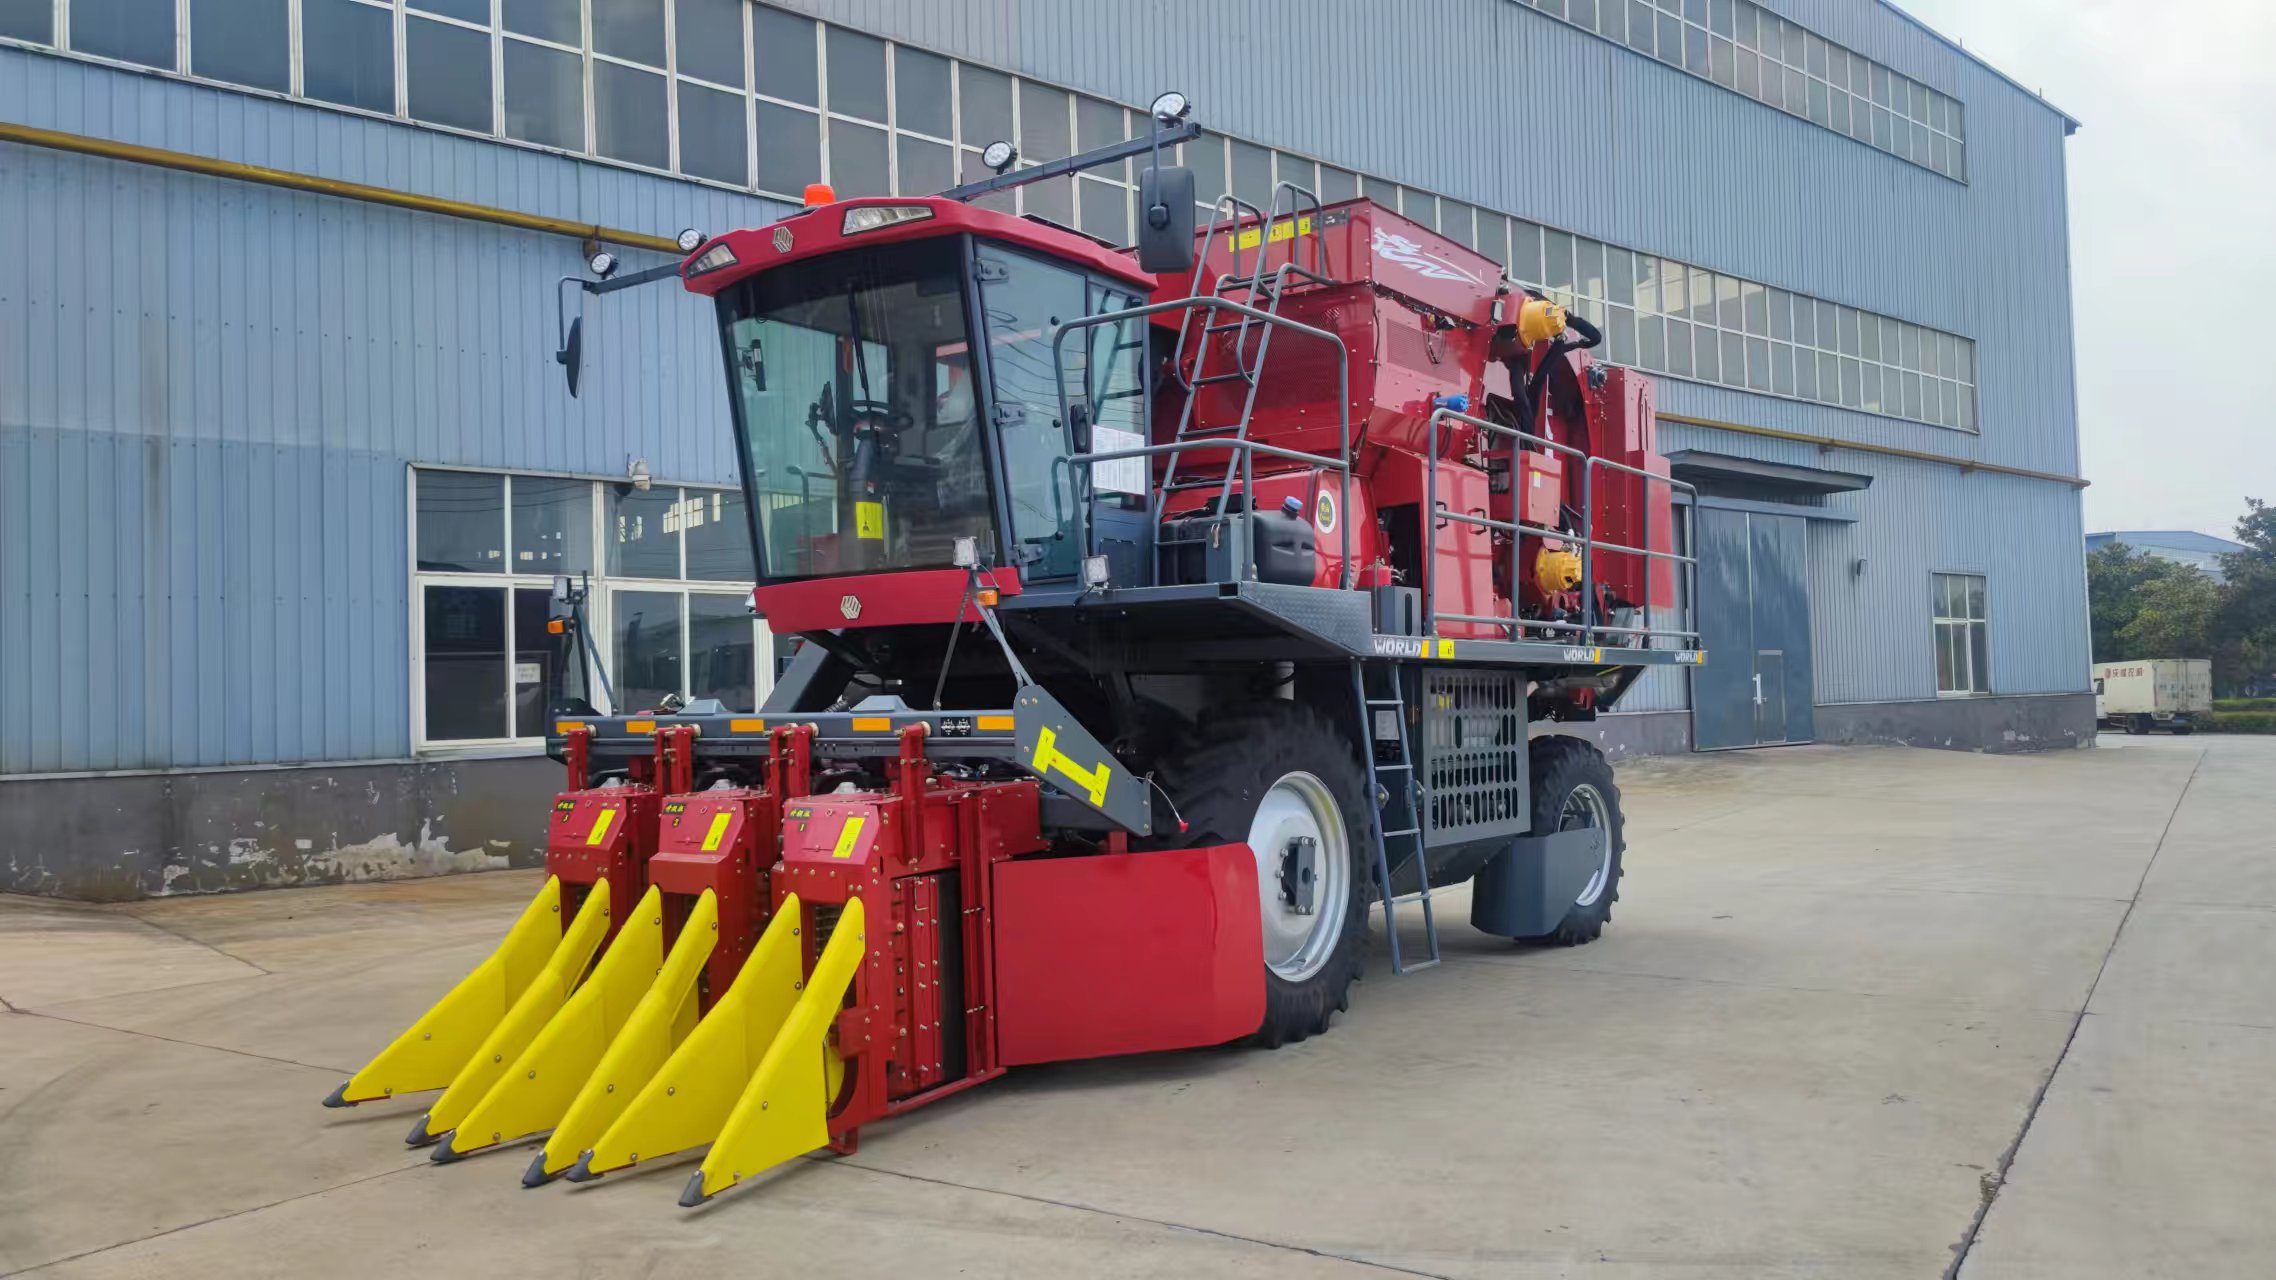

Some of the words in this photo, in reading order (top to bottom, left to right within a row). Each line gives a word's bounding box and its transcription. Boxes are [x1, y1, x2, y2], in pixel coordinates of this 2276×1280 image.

[1373, 639, 1421, 657] WORLD
[1563, 648, 1595, 662] WORLD
[1674, 651, 1698, 664] WORLD
